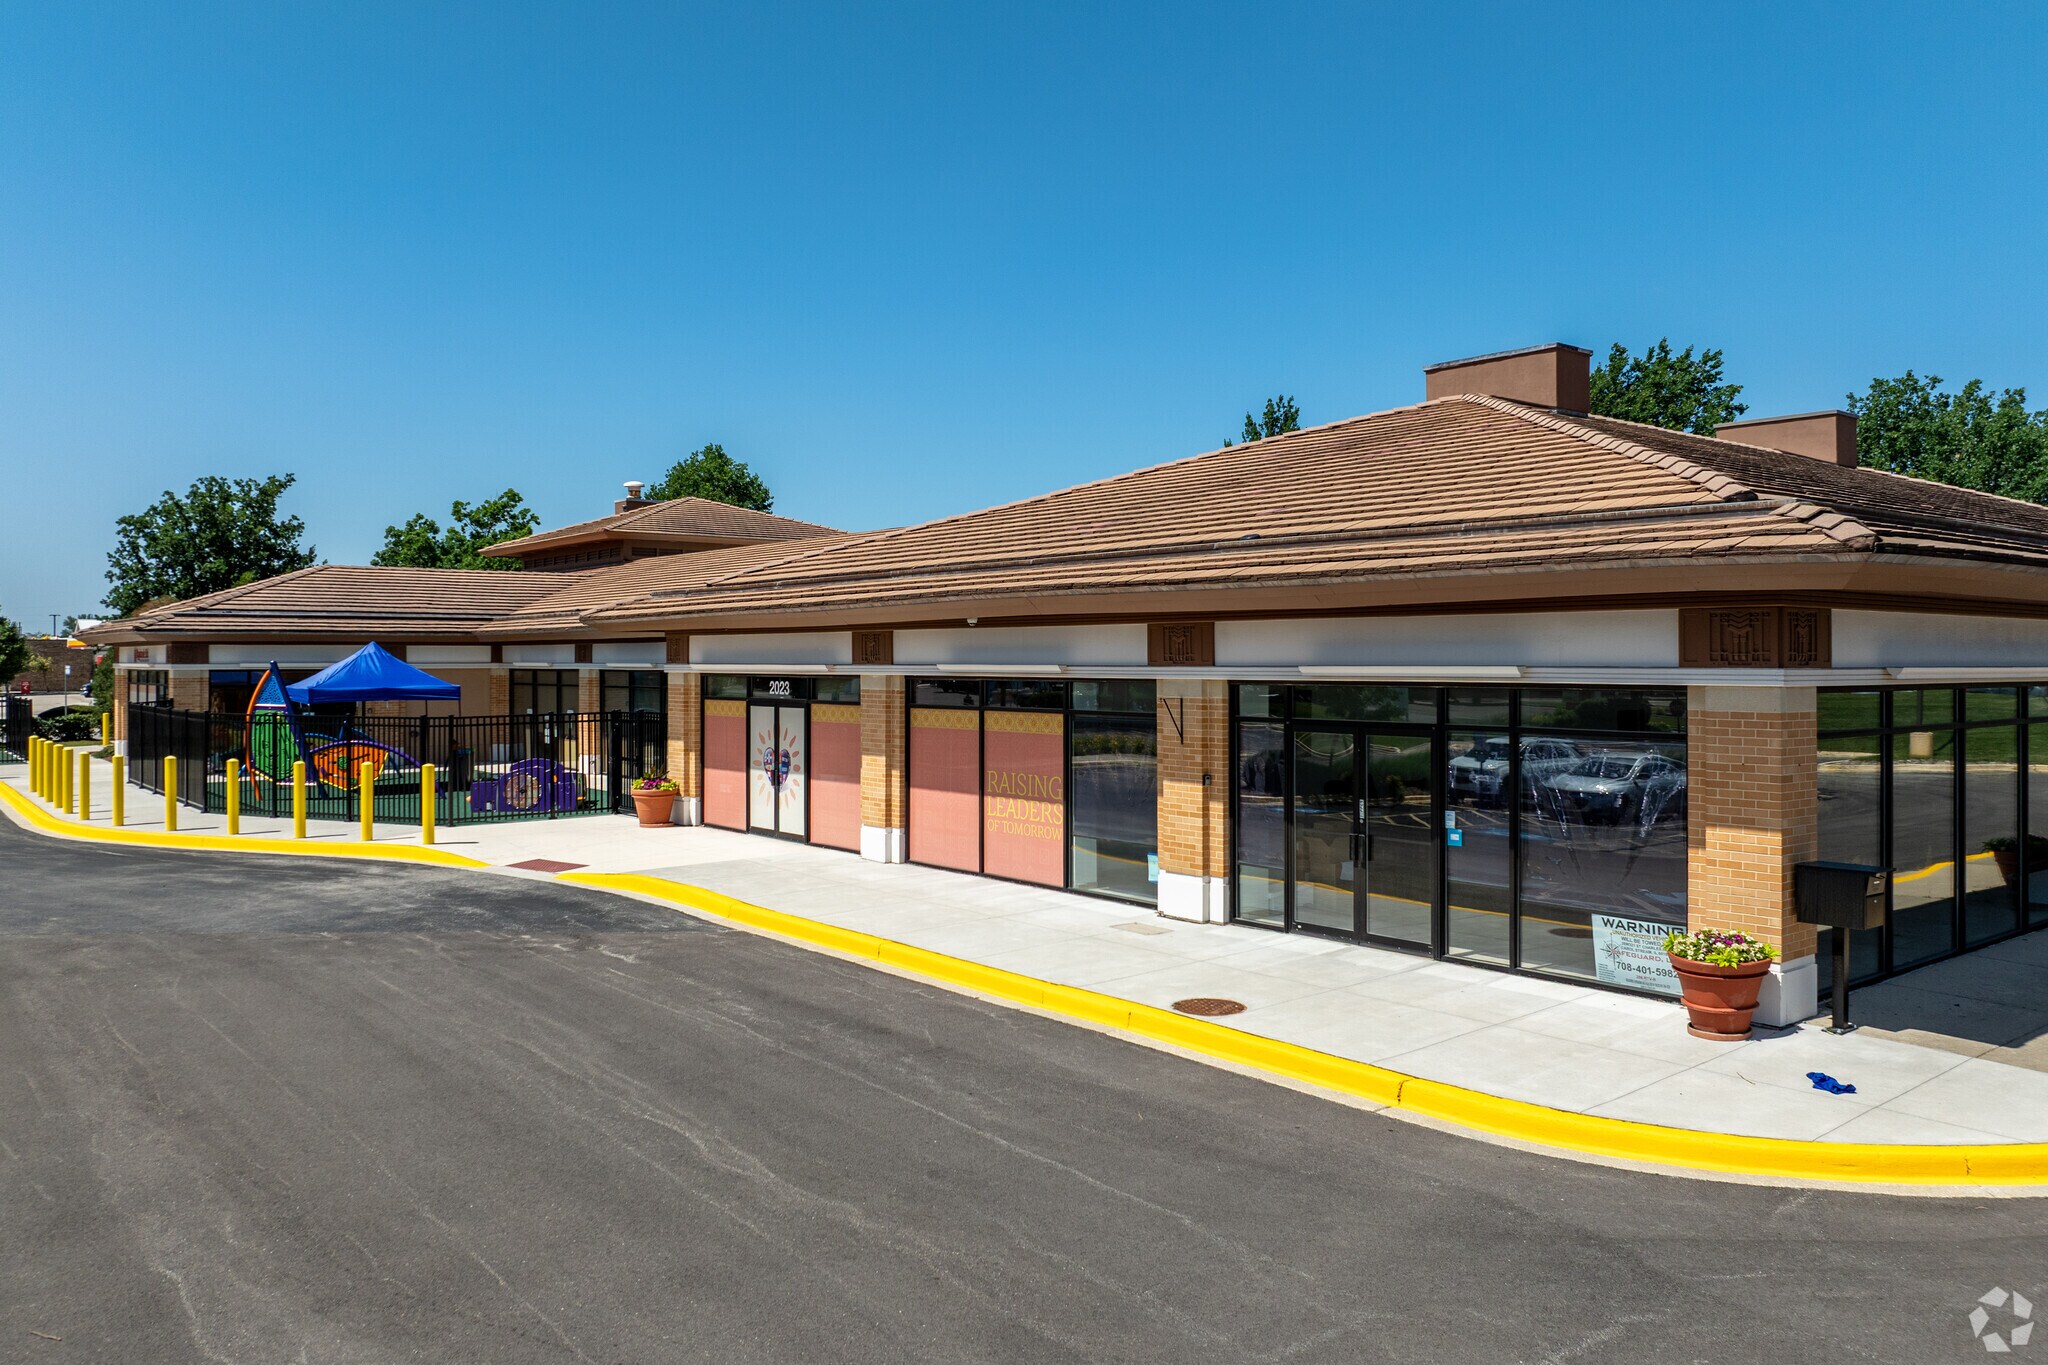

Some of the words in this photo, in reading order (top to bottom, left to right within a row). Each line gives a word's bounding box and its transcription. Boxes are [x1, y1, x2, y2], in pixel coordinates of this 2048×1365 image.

[769, 681, 790, 695] 2023
[987, 770, 1063, 800] RAISING
[987, 796, 1063, 825] LEADERS
[987, 819, 999, 832] OF
[1002, 820, 1063, 840] TOMORROW
[1601, 917, 1684, 936] WARNING
[1616, 961, 1679, 978] 708-401-5982
